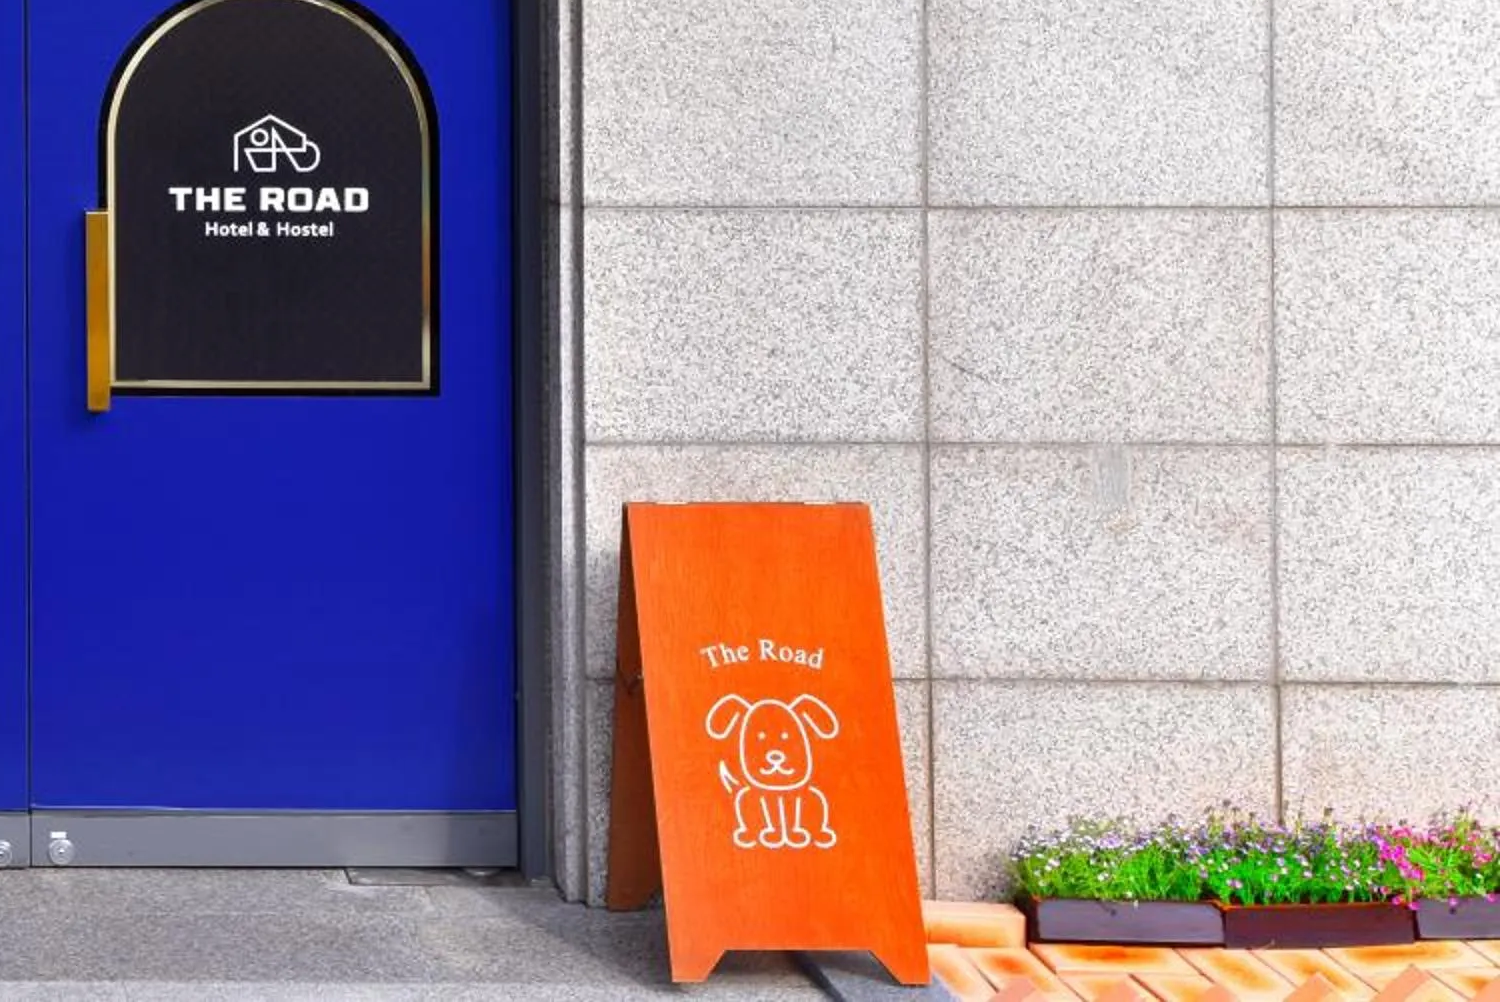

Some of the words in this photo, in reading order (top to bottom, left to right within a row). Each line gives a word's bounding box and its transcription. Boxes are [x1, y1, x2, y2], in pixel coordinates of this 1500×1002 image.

[168, 186, 247, 212] THE
[259, 186, 369, 213] ROAD
[205, 221, 253, 237] Hotel
[256, 221, 270, 237] &
[276, 221, 334, 237] Hostel
[700, 643, 749, 669] The
[758, 638, 824, 670] Road
